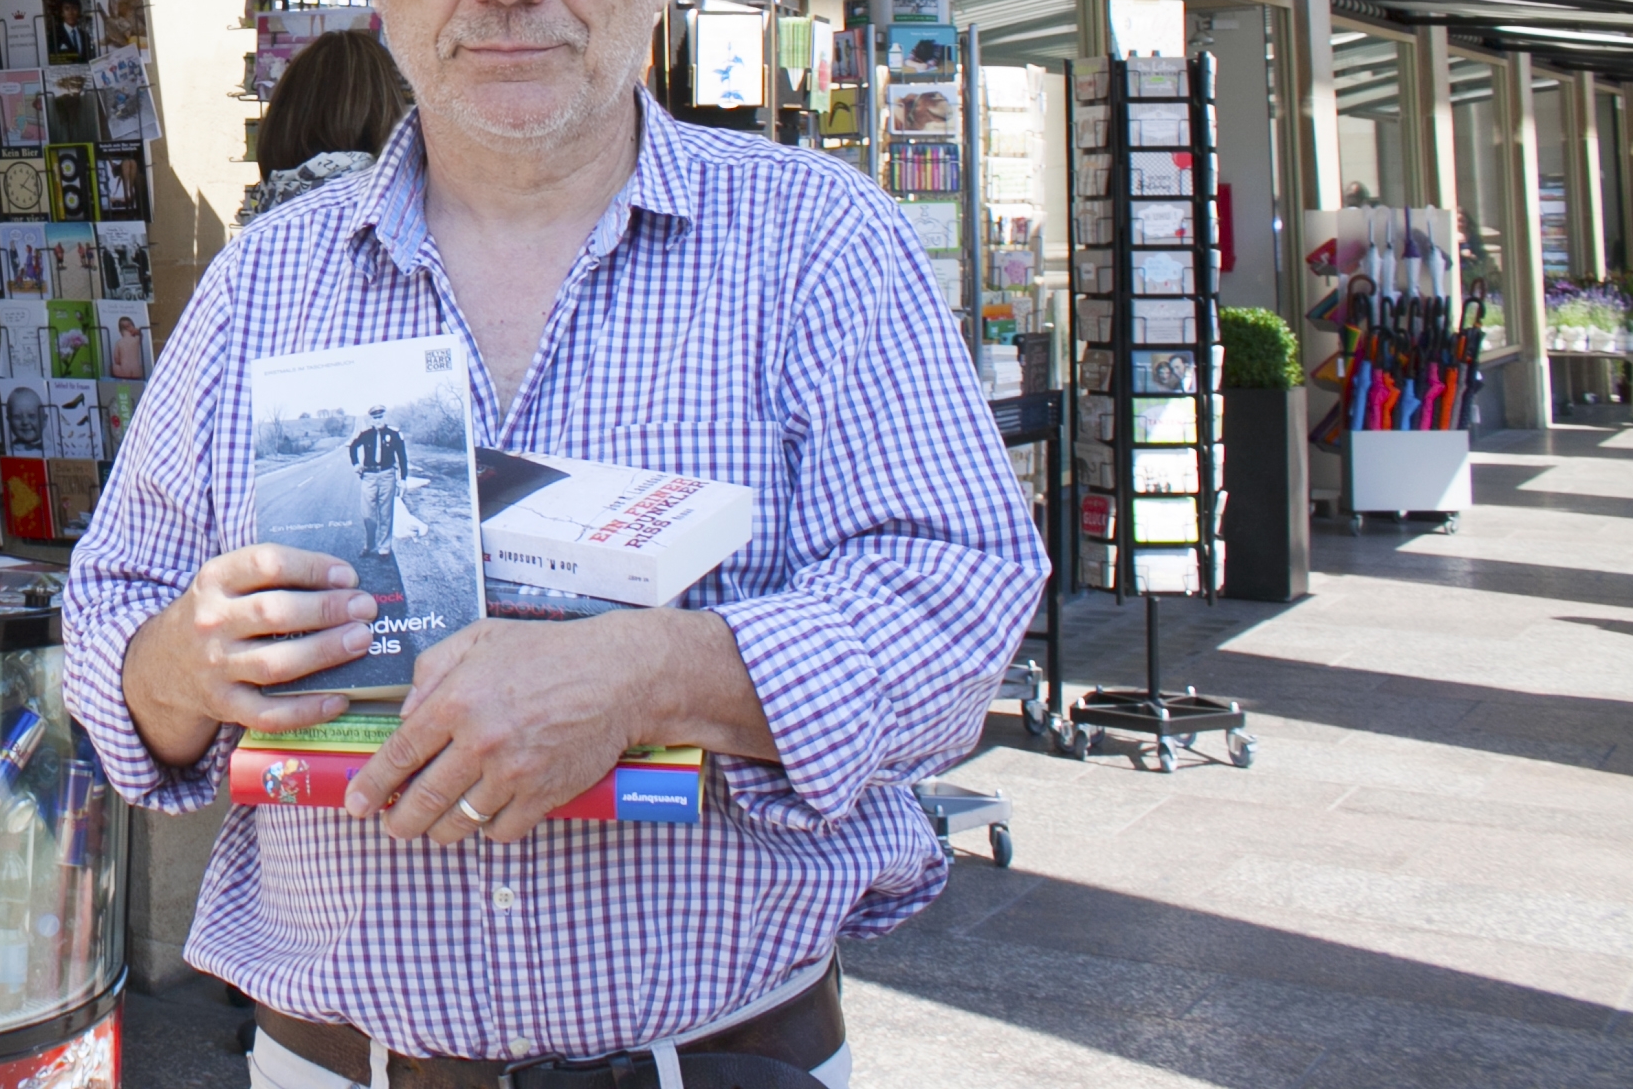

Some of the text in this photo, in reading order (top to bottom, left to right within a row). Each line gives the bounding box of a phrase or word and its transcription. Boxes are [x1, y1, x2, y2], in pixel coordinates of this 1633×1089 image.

[1, 147, 39, 158] Kein Bier
[426, 349, 451, 358] HEYNE
[426, 356, 452, 364] HARD
[264, 359, 355, 376] ERSTMALS IM TASCHENBUCH
[426, 362, 452, 371] CORE
[588, 476, 695, 544] EIN FEINER
[624, 480, 711, 533] DUNKLER
[328, 519, 353, 528] Focus
[623, 518, 673, 549] RISS
[498, 548, 544, 570] Lansdale
[559, 560, 579, 575] Joe
[369, 610, 447, 634] dwerk
[331, 726, 360, 739] einer
[622, 791, 688, 806] Ravensburger
